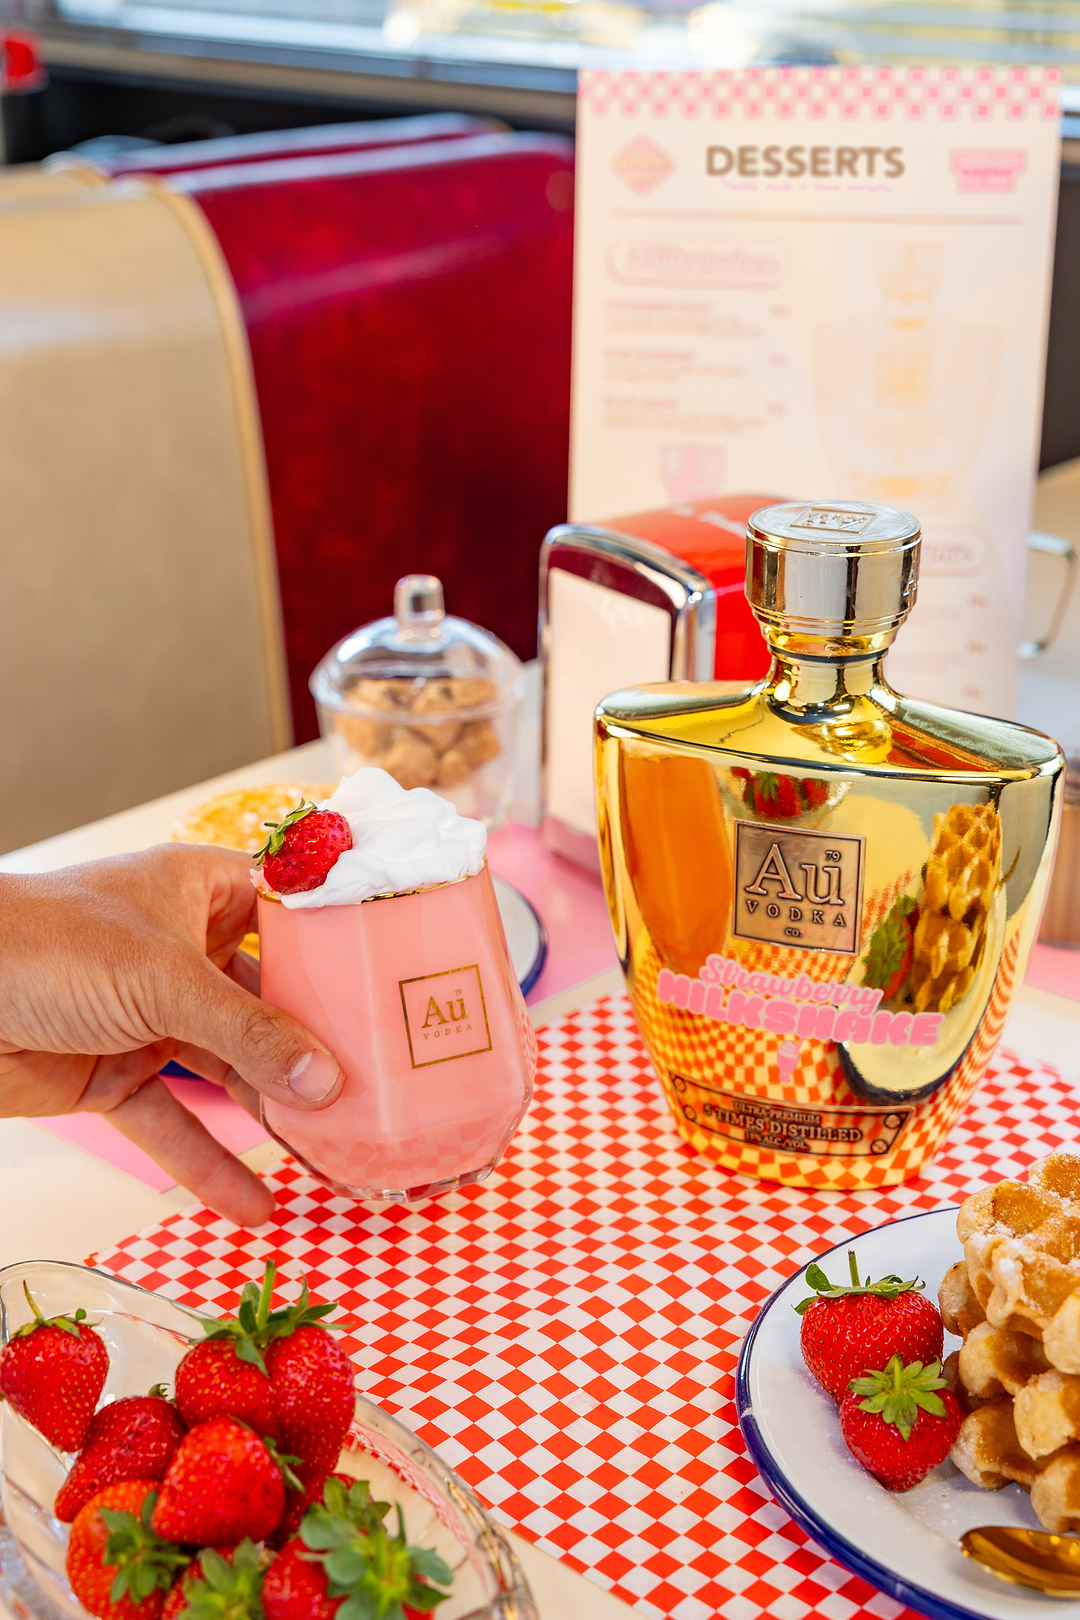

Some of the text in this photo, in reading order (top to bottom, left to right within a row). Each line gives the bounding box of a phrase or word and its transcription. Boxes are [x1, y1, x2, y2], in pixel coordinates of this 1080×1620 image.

[705, 144, 906, 179] DESSERTS
[825, 849, 841, 862] 79
[745, 899, 847, 928] VODKA
[699, 954, 884, 1016] Strawberry
[657, 968, 945, 1046] MILKSHAKE
[423, 1024, 472, 1040] VODKA
[714, 1106, 766, 1132] TIMES
[769, 1119, 863, 1142] DISTILLED
